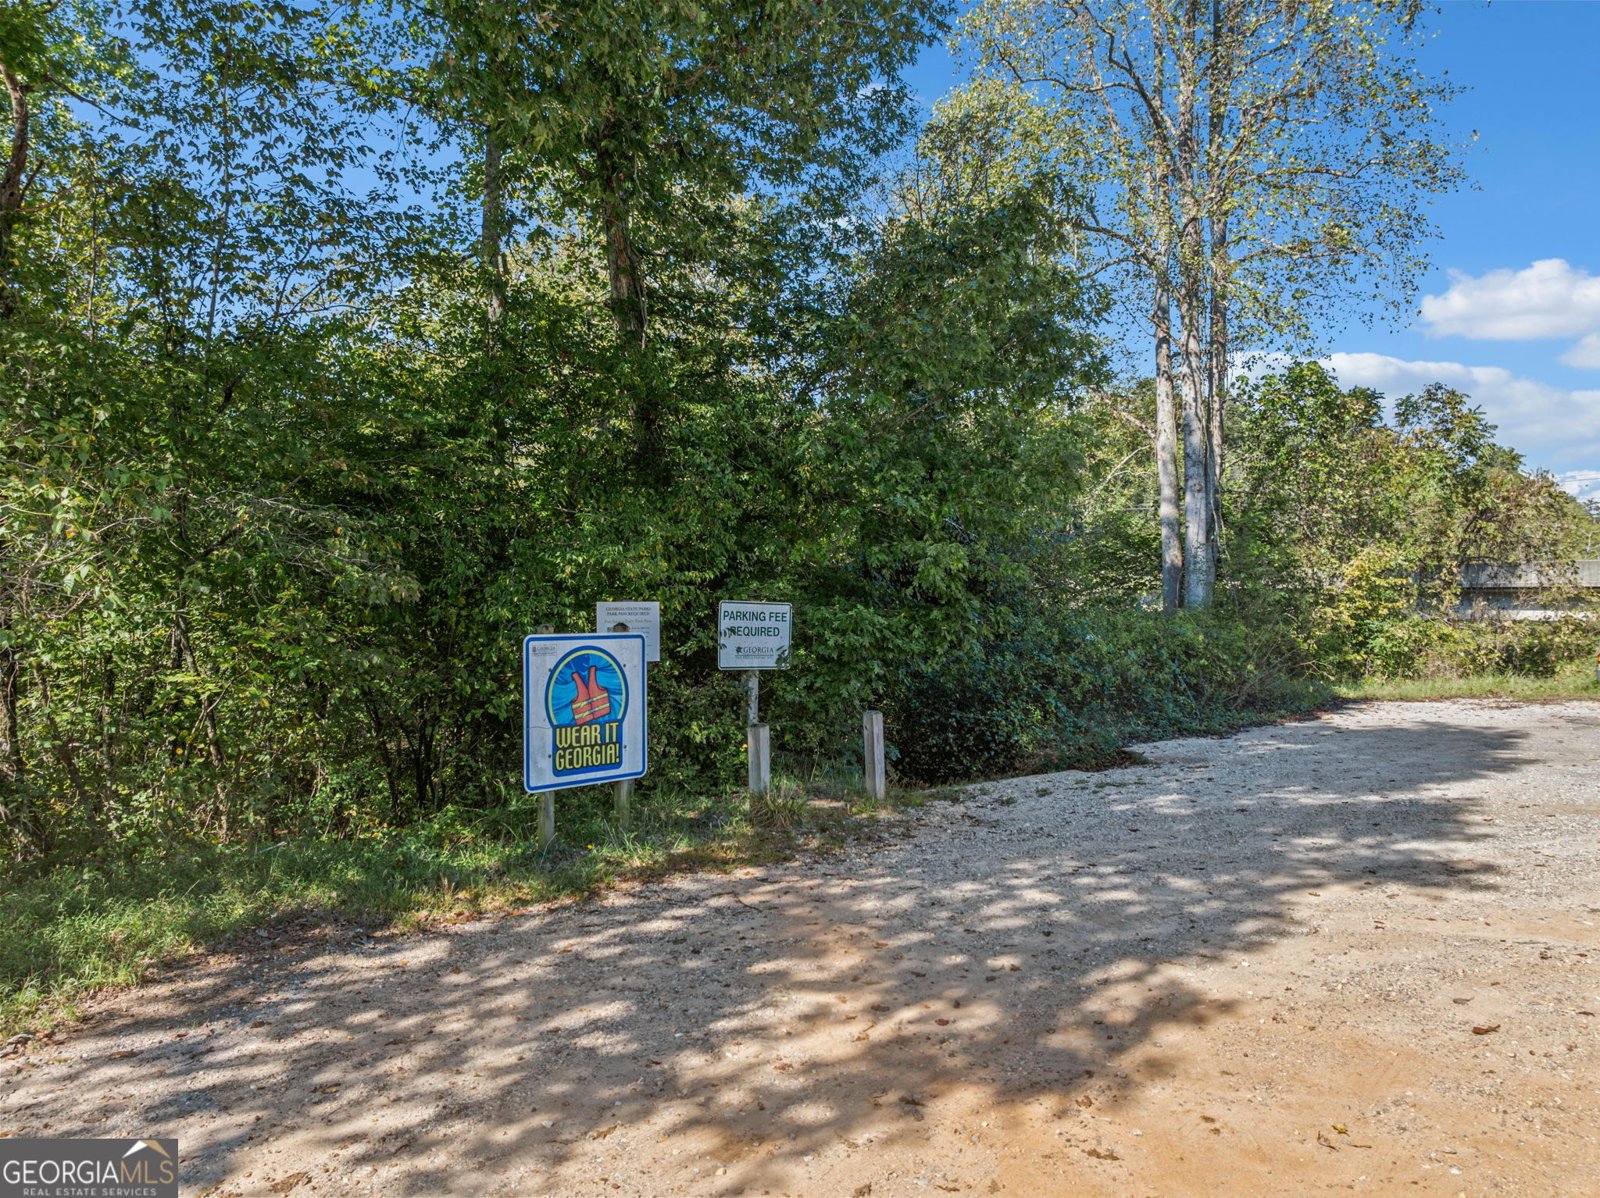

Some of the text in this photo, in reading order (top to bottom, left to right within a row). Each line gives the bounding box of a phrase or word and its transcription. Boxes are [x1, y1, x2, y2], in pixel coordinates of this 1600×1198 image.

[723, 610, 788, 622] PARKING FEE
[556, 722, 619, 748] WEAR IT
[556, 744, 620, 770] GEORGIA!
